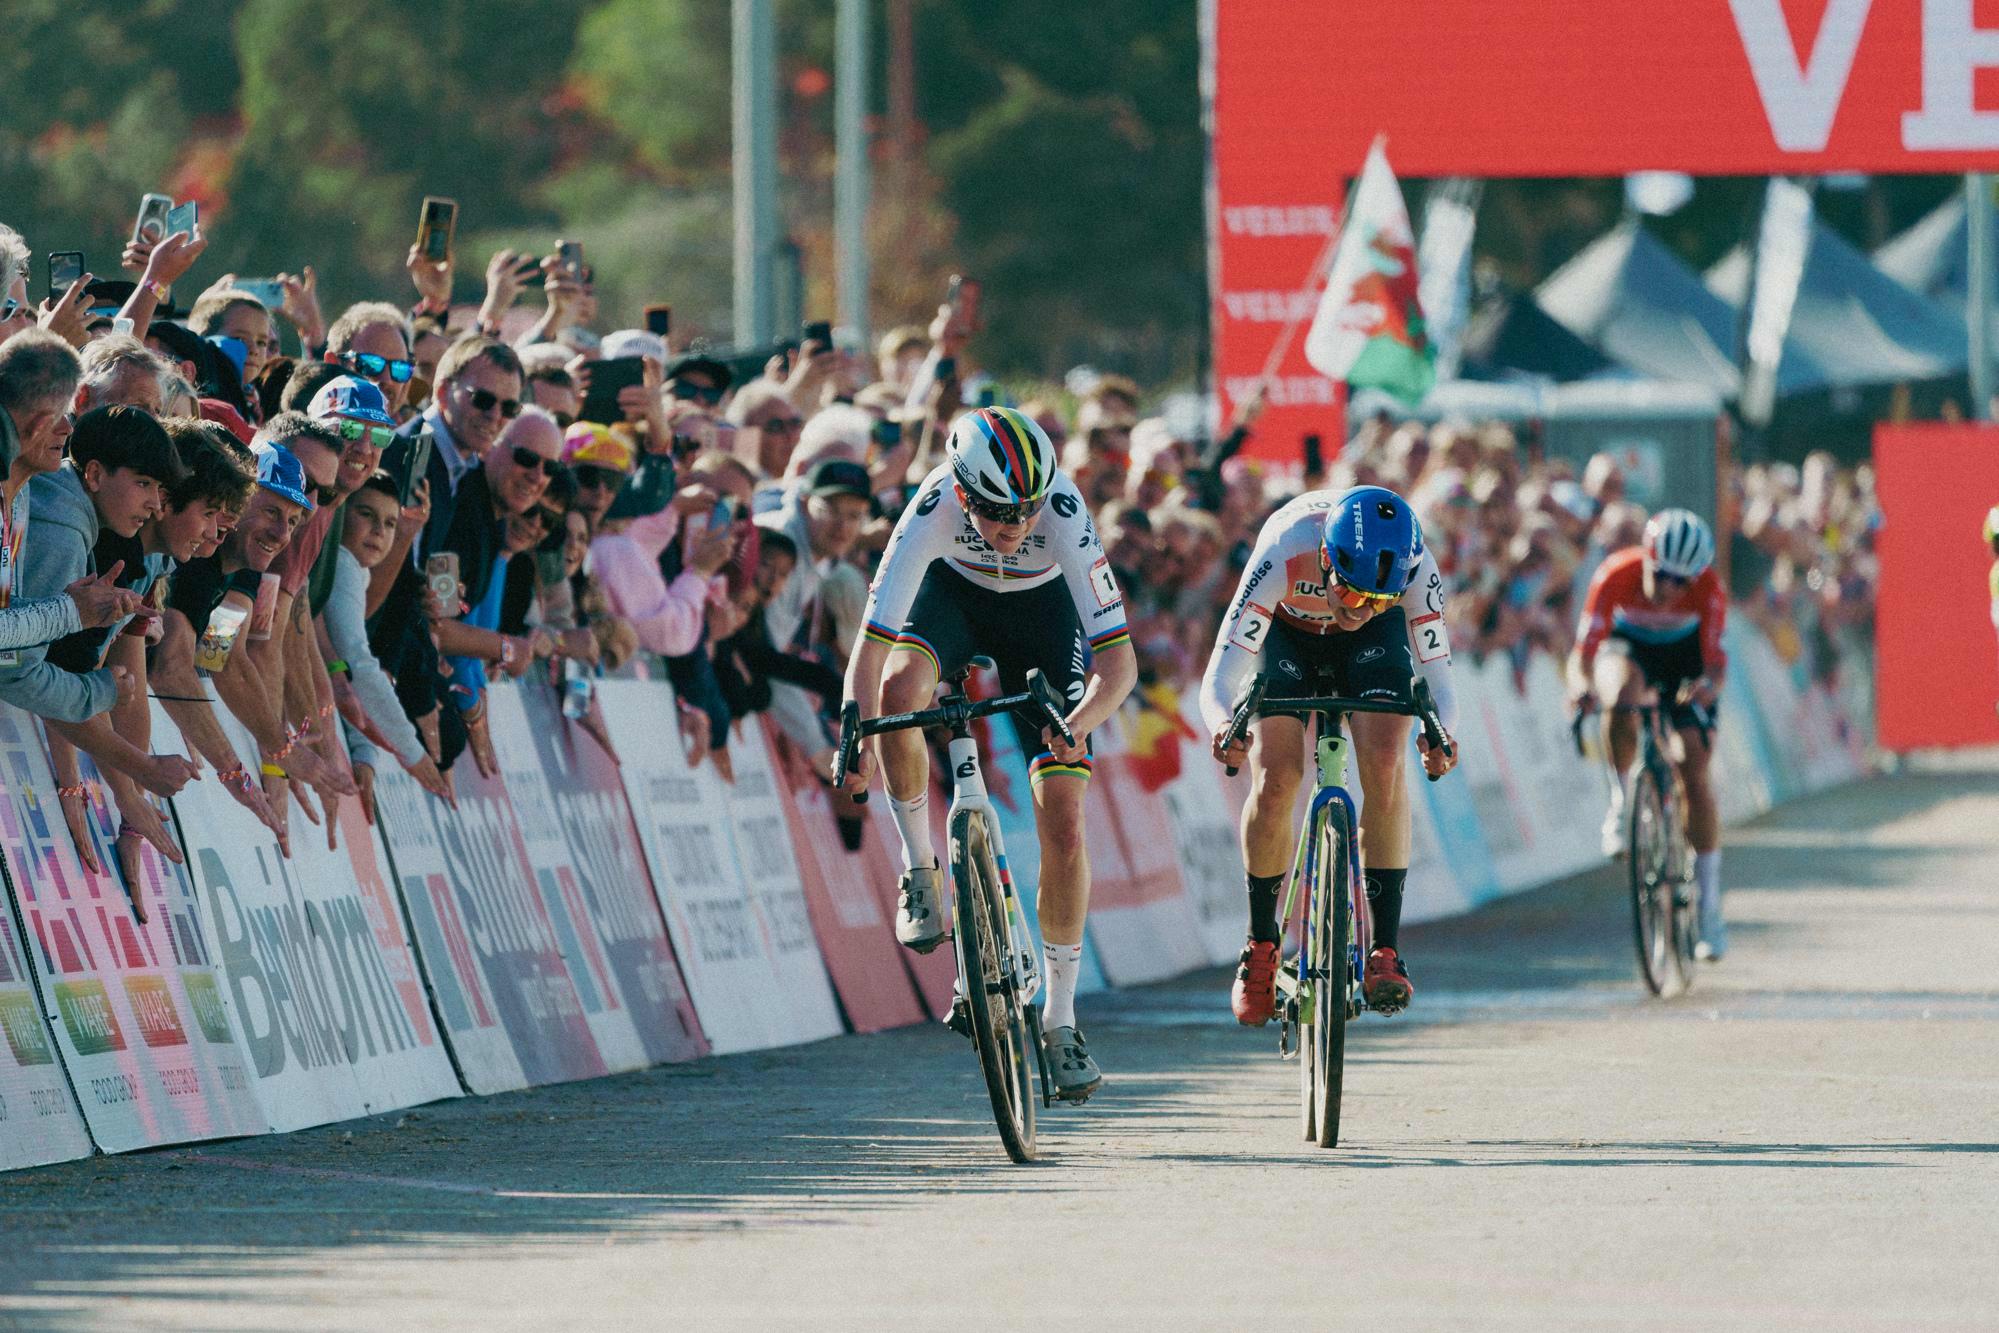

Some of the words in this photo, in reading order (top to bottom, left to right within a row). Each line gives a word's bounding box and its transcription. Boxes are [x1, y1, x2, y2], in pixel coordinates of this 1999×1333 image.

[1352, 501, 1364, 551] TREK
[961, 535, 985, 543] UC
[1103, 572, 1114, 592] 1
[1300, 581, 1326, 598] UC
[1244, 619, 1262, 642] 2
[1424, 628, 1440, 650] 2
[197, 842, 418, 1080] Benidorm
[65, 993, 116, 1039] WARE
[131, 990, 177, 1032] WARE
